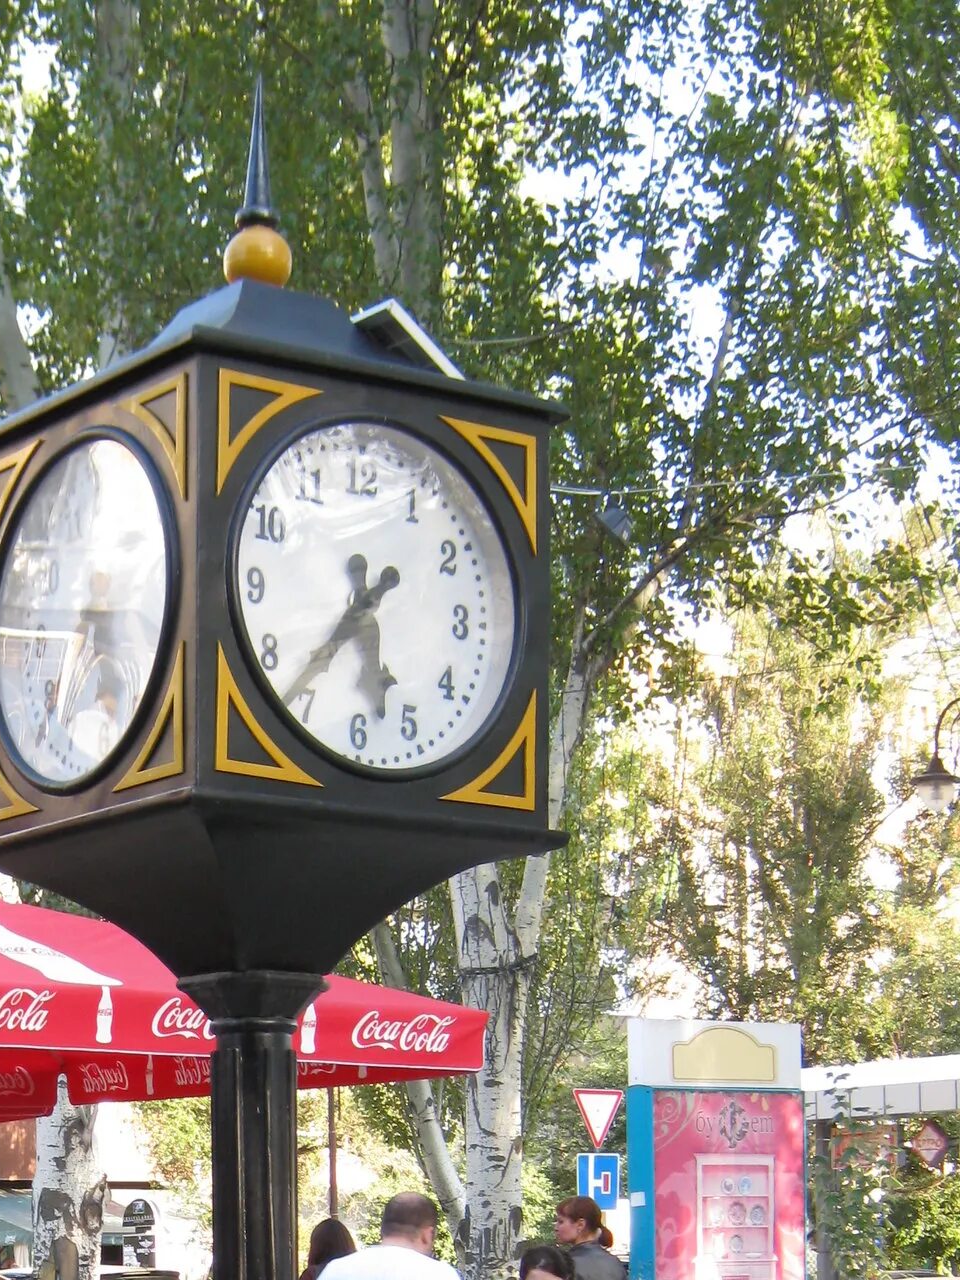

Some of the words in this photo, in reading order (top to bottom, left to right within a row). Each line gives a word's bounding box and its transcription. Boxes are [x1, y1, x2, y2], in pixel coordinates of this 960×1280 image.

[296, 465, 324, 505] 11
[346, 457, 378, 497] 12
[255, 504, 287, 544] 10
[405, 488, 419, 523] 1
[439, 539, 458, 576] 2
[246, 566, 266, 604] 9
[452, 604, 469, 641] 3
[260, 632, 279, 671] 8
[437, 665, 455, 701] 4
[298, 687, 316, 724] 7
[400, 703, 418, 741] 5
[349, 713, 368, 750] 6
[351, 1010, 456, 1053] Coca-Cola
